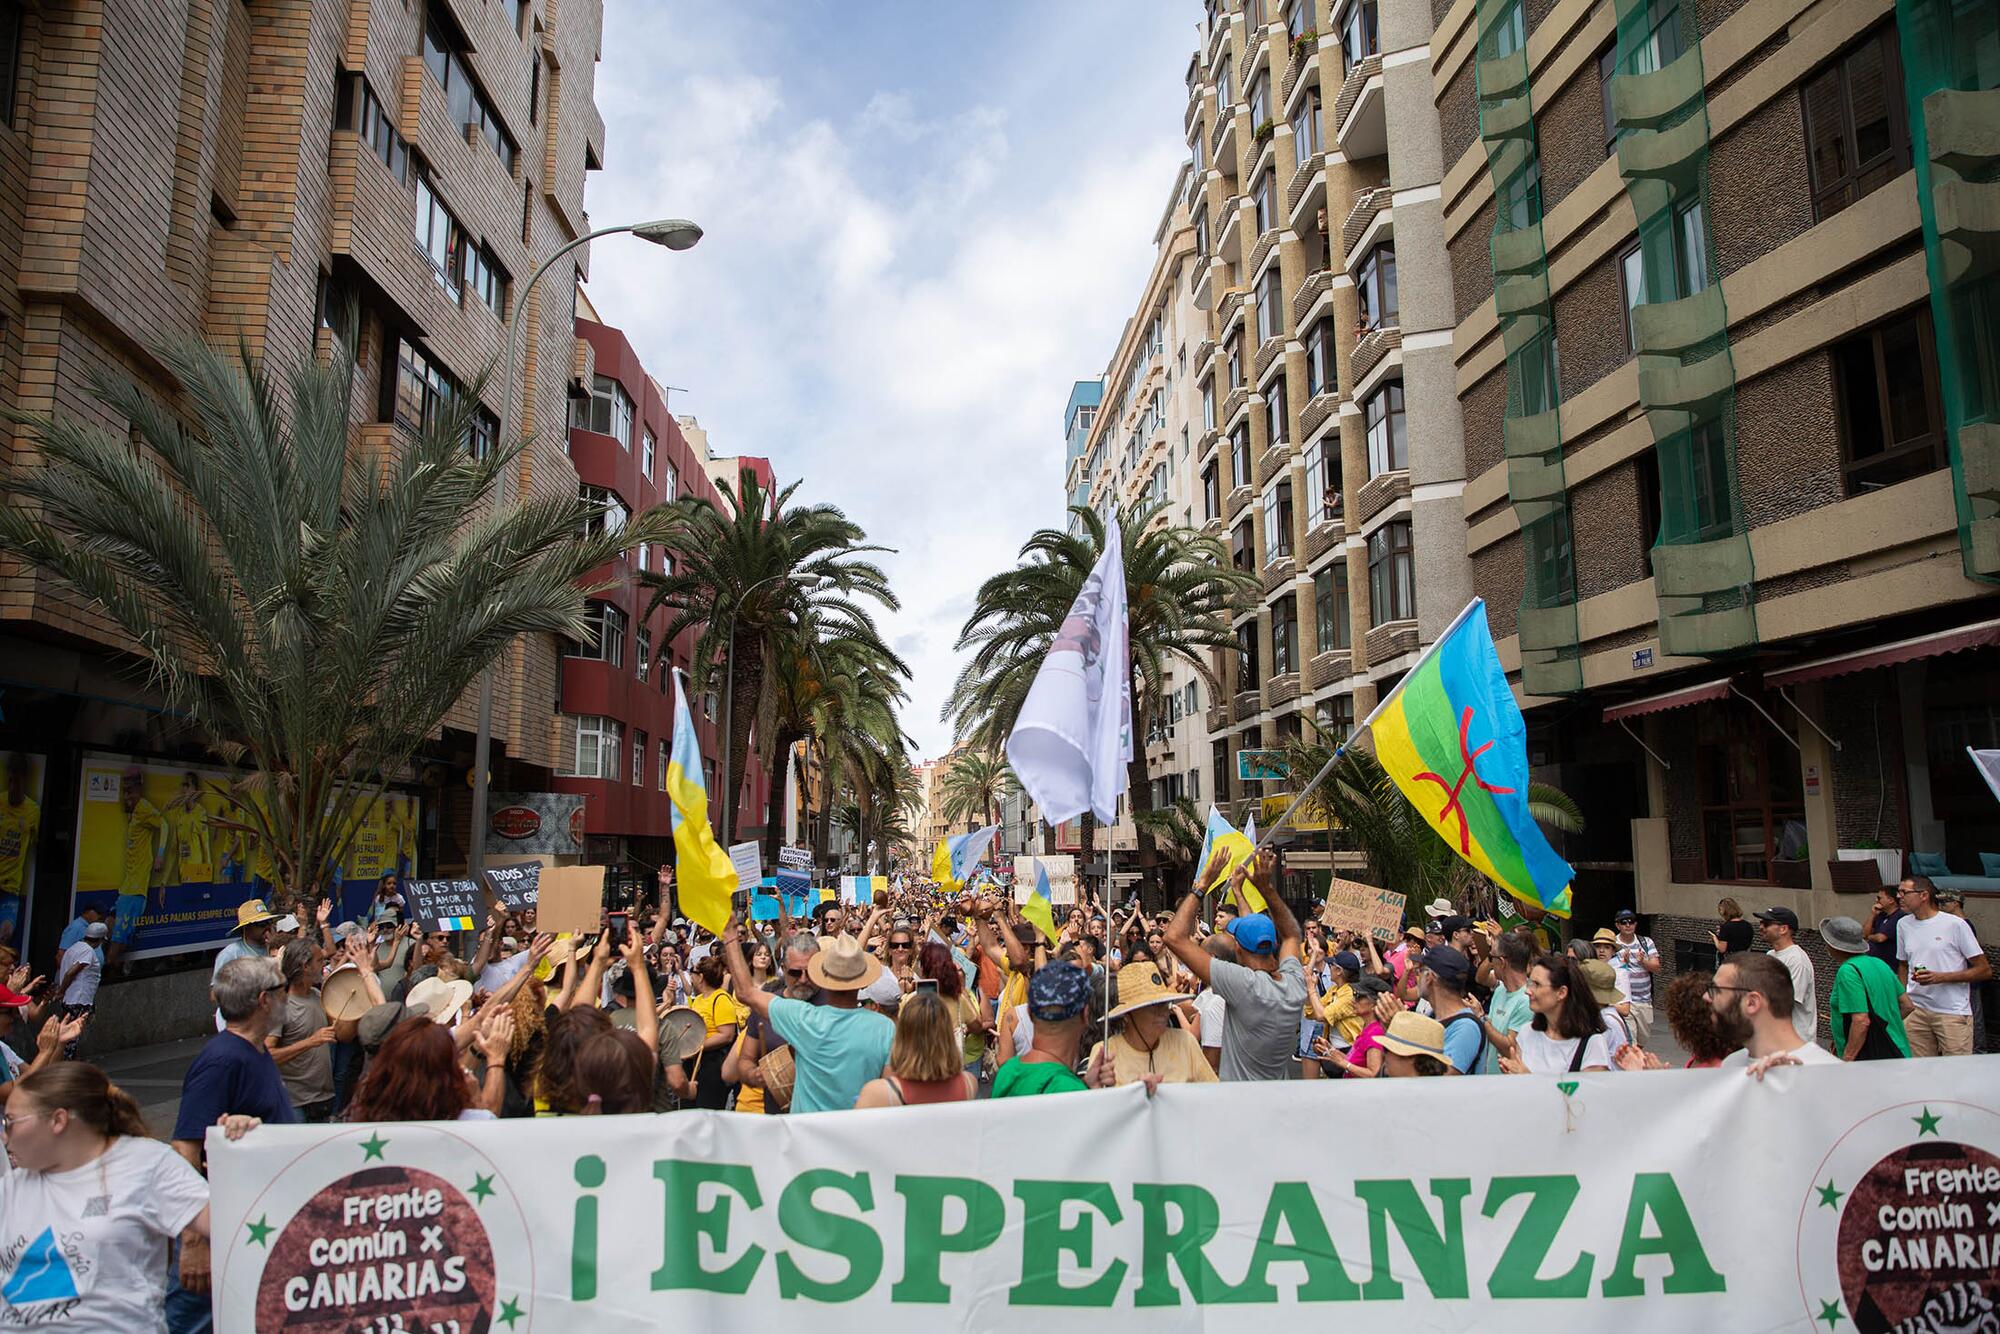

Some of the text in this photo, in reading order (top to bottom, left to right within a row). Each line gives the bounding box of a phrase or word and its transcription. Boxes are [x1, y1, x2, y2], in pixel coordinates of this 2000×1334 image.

[487, 868, 523, 881] TODOS
[409, 882, 428, 896] NO
[430, 882, 449, 894] ES
[500, 878, 538, 892] VECINOS
[420, 897, 432, 906] ES
[436, 894, 461, 905] AMOR
[502, 894, 521, 905] SON
[132, 916, 155, 927] LLEVA
[156, 914, 168, 924] LAS
[170, 911, 196, 922] PALMAS
[197, 908, 223, 920] SIEMPRE
[419, 904, 476, 919] MI TIERRA
[1904, 1164, 2000, 1196] Frente
[343, 1184, 444, 1228] Frente
[1878, 1195, 1974, 1231] común
[650, 1158, 1727, 1308] ESPERANZA
[309, 1221, 407, 1268] común
[284, 1256, 466, 1312] CANARIAS
